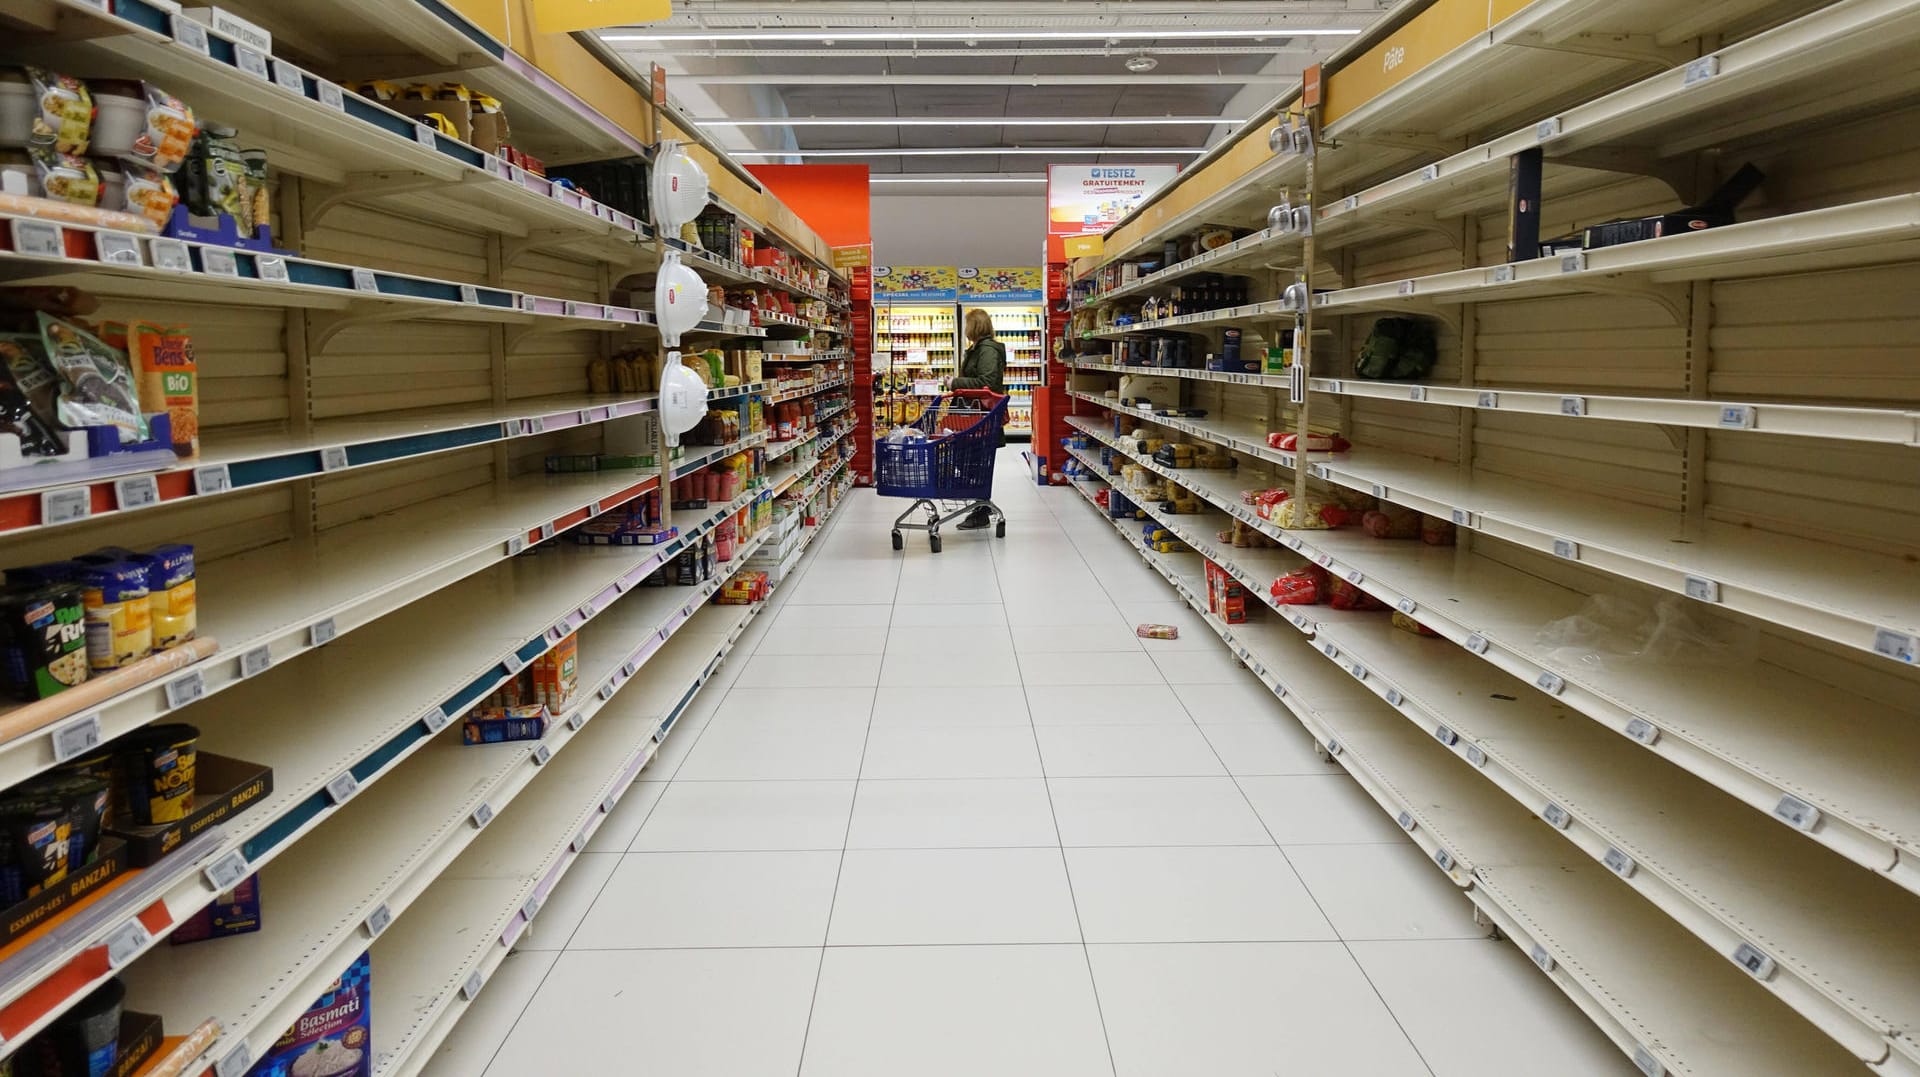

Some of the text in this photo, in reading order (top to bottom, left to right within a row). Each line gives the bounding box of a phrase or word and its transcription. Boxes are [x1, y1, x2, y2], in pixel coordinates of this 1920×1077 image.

[1383, 47, 1405, 73] Pâte
[1102, 168, 1136, 178] TESTEZ
[300, 997, 360, 1032] Basmati
